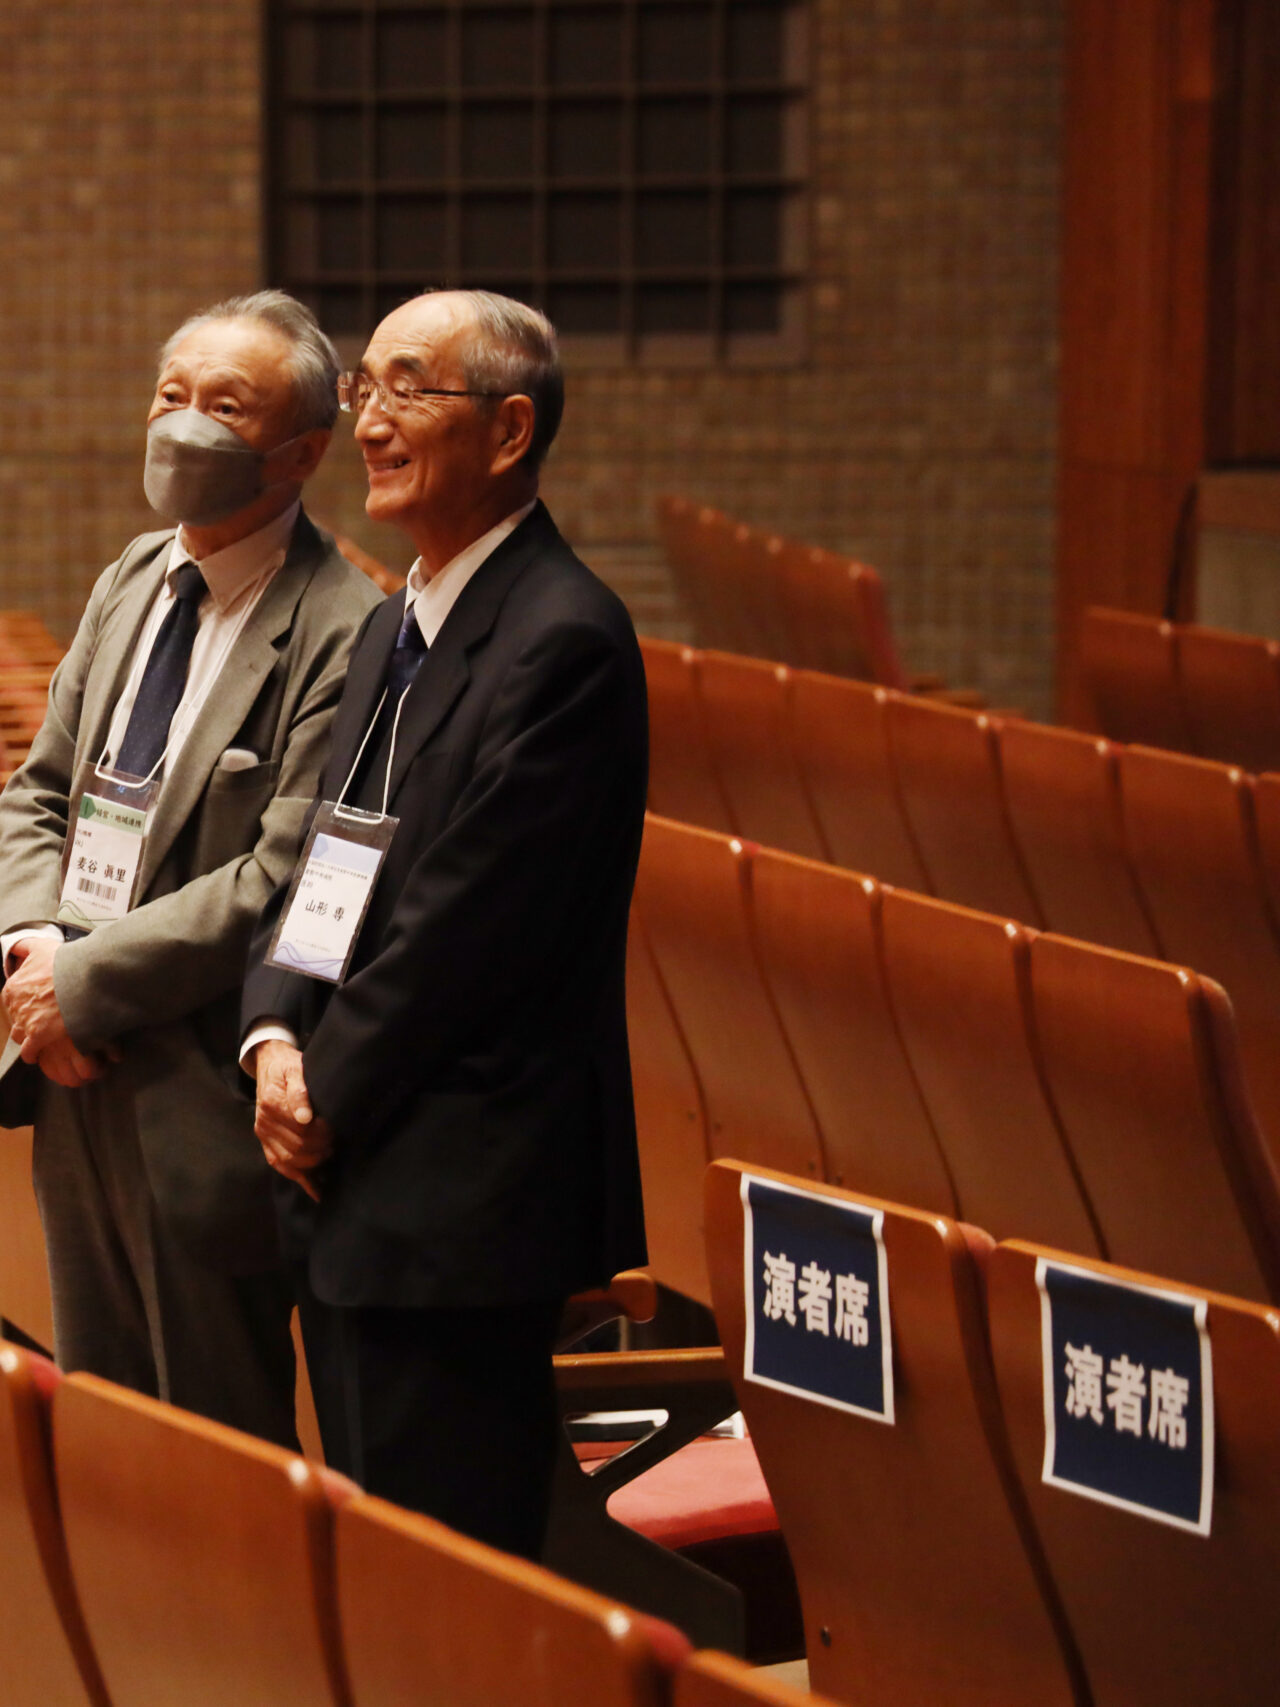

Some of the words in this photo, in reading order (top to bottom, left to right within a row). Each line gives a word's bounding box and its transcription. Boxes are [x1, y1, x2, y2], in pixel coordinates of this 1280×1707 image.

[76, 855, 98, 874] 麦谷
[305, 899, 328, 916] 山形
[762, 1250, 869, 1346] 演者席
[1064, 1341, 1189, 1449] 演者席
